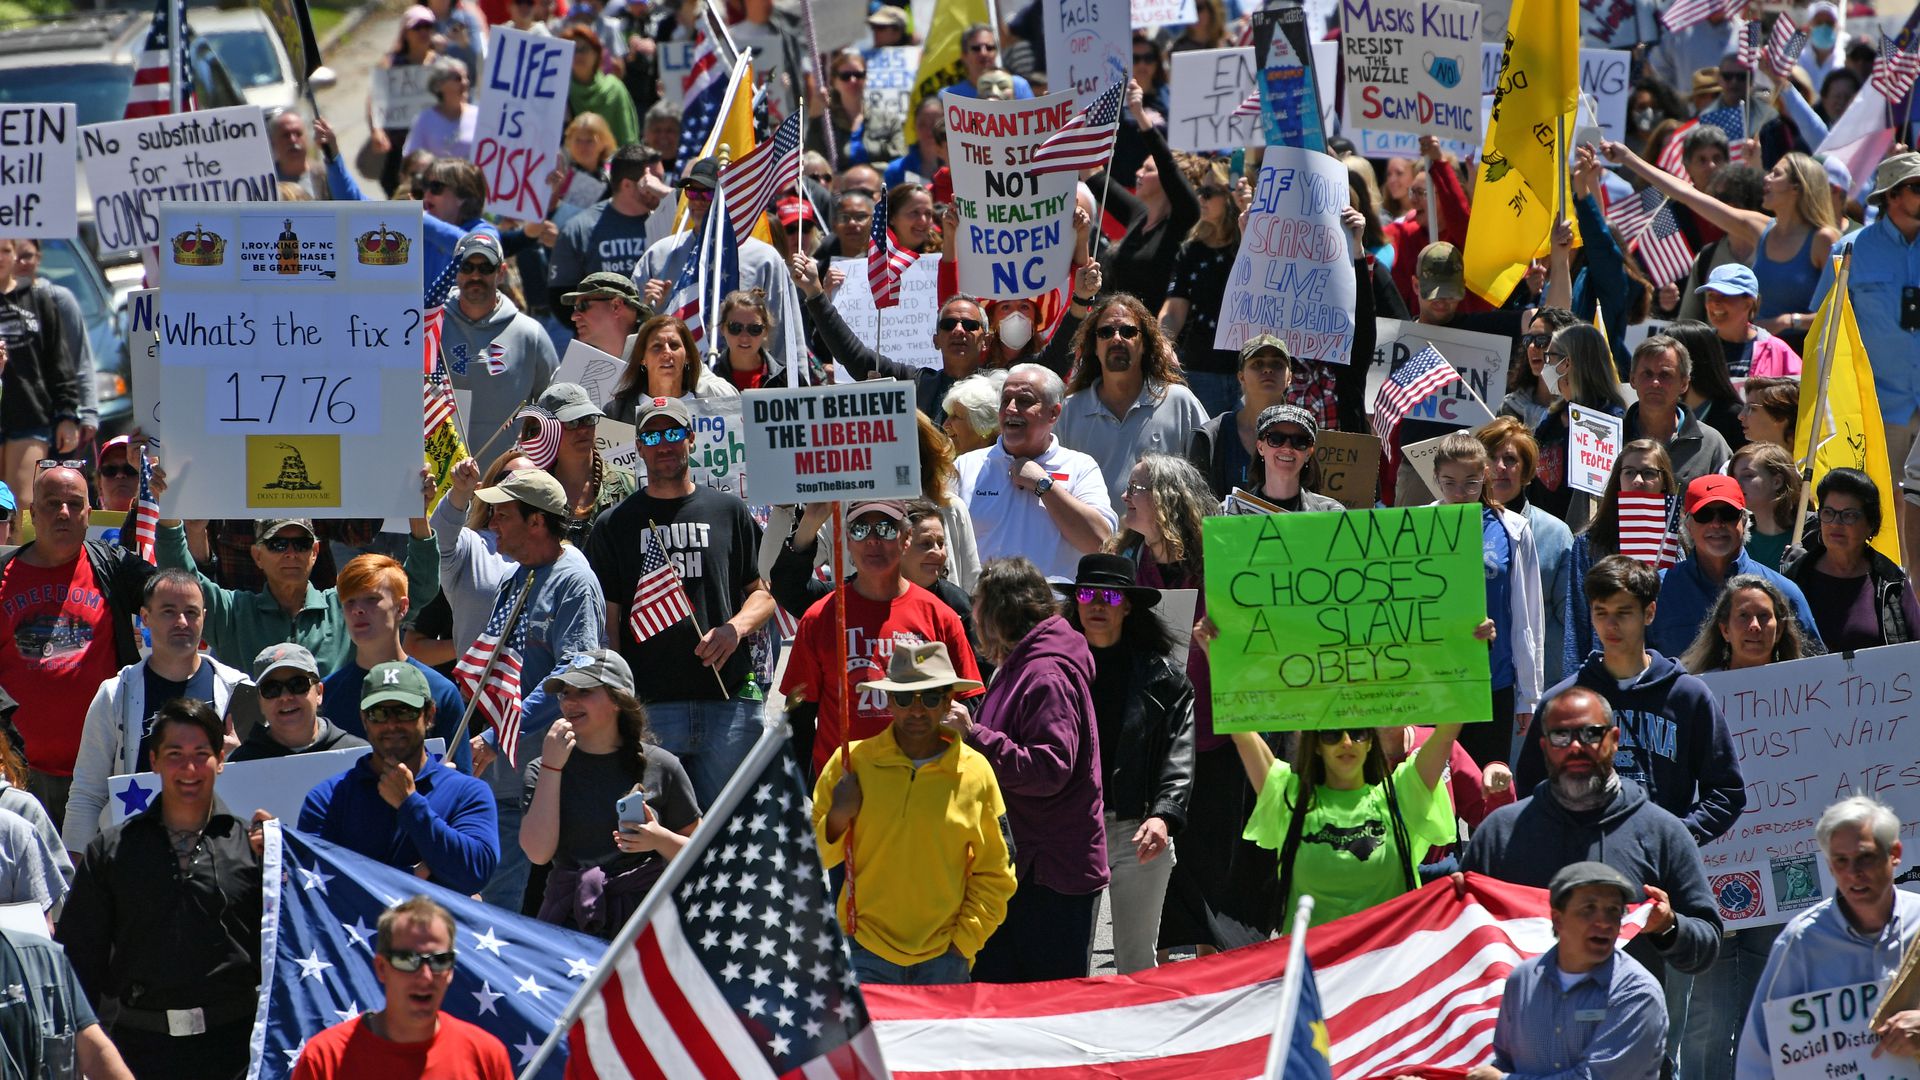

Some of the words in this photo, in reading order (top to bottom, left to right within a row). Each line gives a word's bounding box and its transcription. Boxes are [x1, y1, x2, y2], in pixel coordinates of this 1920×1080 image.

[1422, 2, 1479, 41] KILL!
[1347, 37, 1403, 55] RESIST
[1365, 56, 1388, 67] THE
[491, 35, 562, 99] LIFE
[1348, 66, 1409, 85] MUZZLE
[498, 103, 525, 138] is
[83, 127, 119, 157] No
[138, 120, 257, 151] substitution
[961, 142, 993, 165] THE
[129, 156, 167, 186] for
[183, 151, 221, 178] the
[475, 138, 545, 219] RISK
[985, 170, 1039, 198] NOT
[956, 197, 977, 219] THE
[987, 192, 1068, 223] HEALTHY
[970, 220, 1060, 255] REOPEN
[1249, 215, 1342, 264] SCARED
[992, 256, 1046, 294] NC
[1265, 260, 1331, 302] LIVE
[164, 311, 255, 346] What's
[272, 311, 322, 346] the
[1291, 300, 1350, 334] DEAD
[753, 397, 816, 424] DON'T
[823, 391, 907, 418] BELIEVE
[1413, 395, 1458, 420] NC
[766, 425, 807, 449] THE
[811, 420, 898, 447] LIBERAL
[1574, 432, 1589, 446] WE
[1595, 439, 1614, 456] THE
[795, 448, 872, 475] MEDIA!
[1581, 450, 1612, 472] PEOPLE
[796, 480, 875, 493] StopTheBias.org
[1248, 515, 1293, 566] A
[1326, 505, 1464, 562] MAN
[1230, 558, 1447, 607] CHOOSES
[4, 584, 101, 616] FREEDOM
[1243, 609, 1278, 653] A
[1317, 601, 1444, 647] SLAVE
[383, 668, 401, 684] K
[1279, 645, 1411, 688] OBEYS
[1733, 727, 1811, 761] JUST
[1824, 715, 1909, 749] WAIT
[1742, 774, 1818, 813] JUST
[1742, 818, 1816, 840] OVERDOSES
[1735, 848, 1756, 864] IN
[1734, 874, 1751, 886] MESS
[1790, 984, 1878, 1034] STOP
[1780, 1035, 1829, 1065] Social
